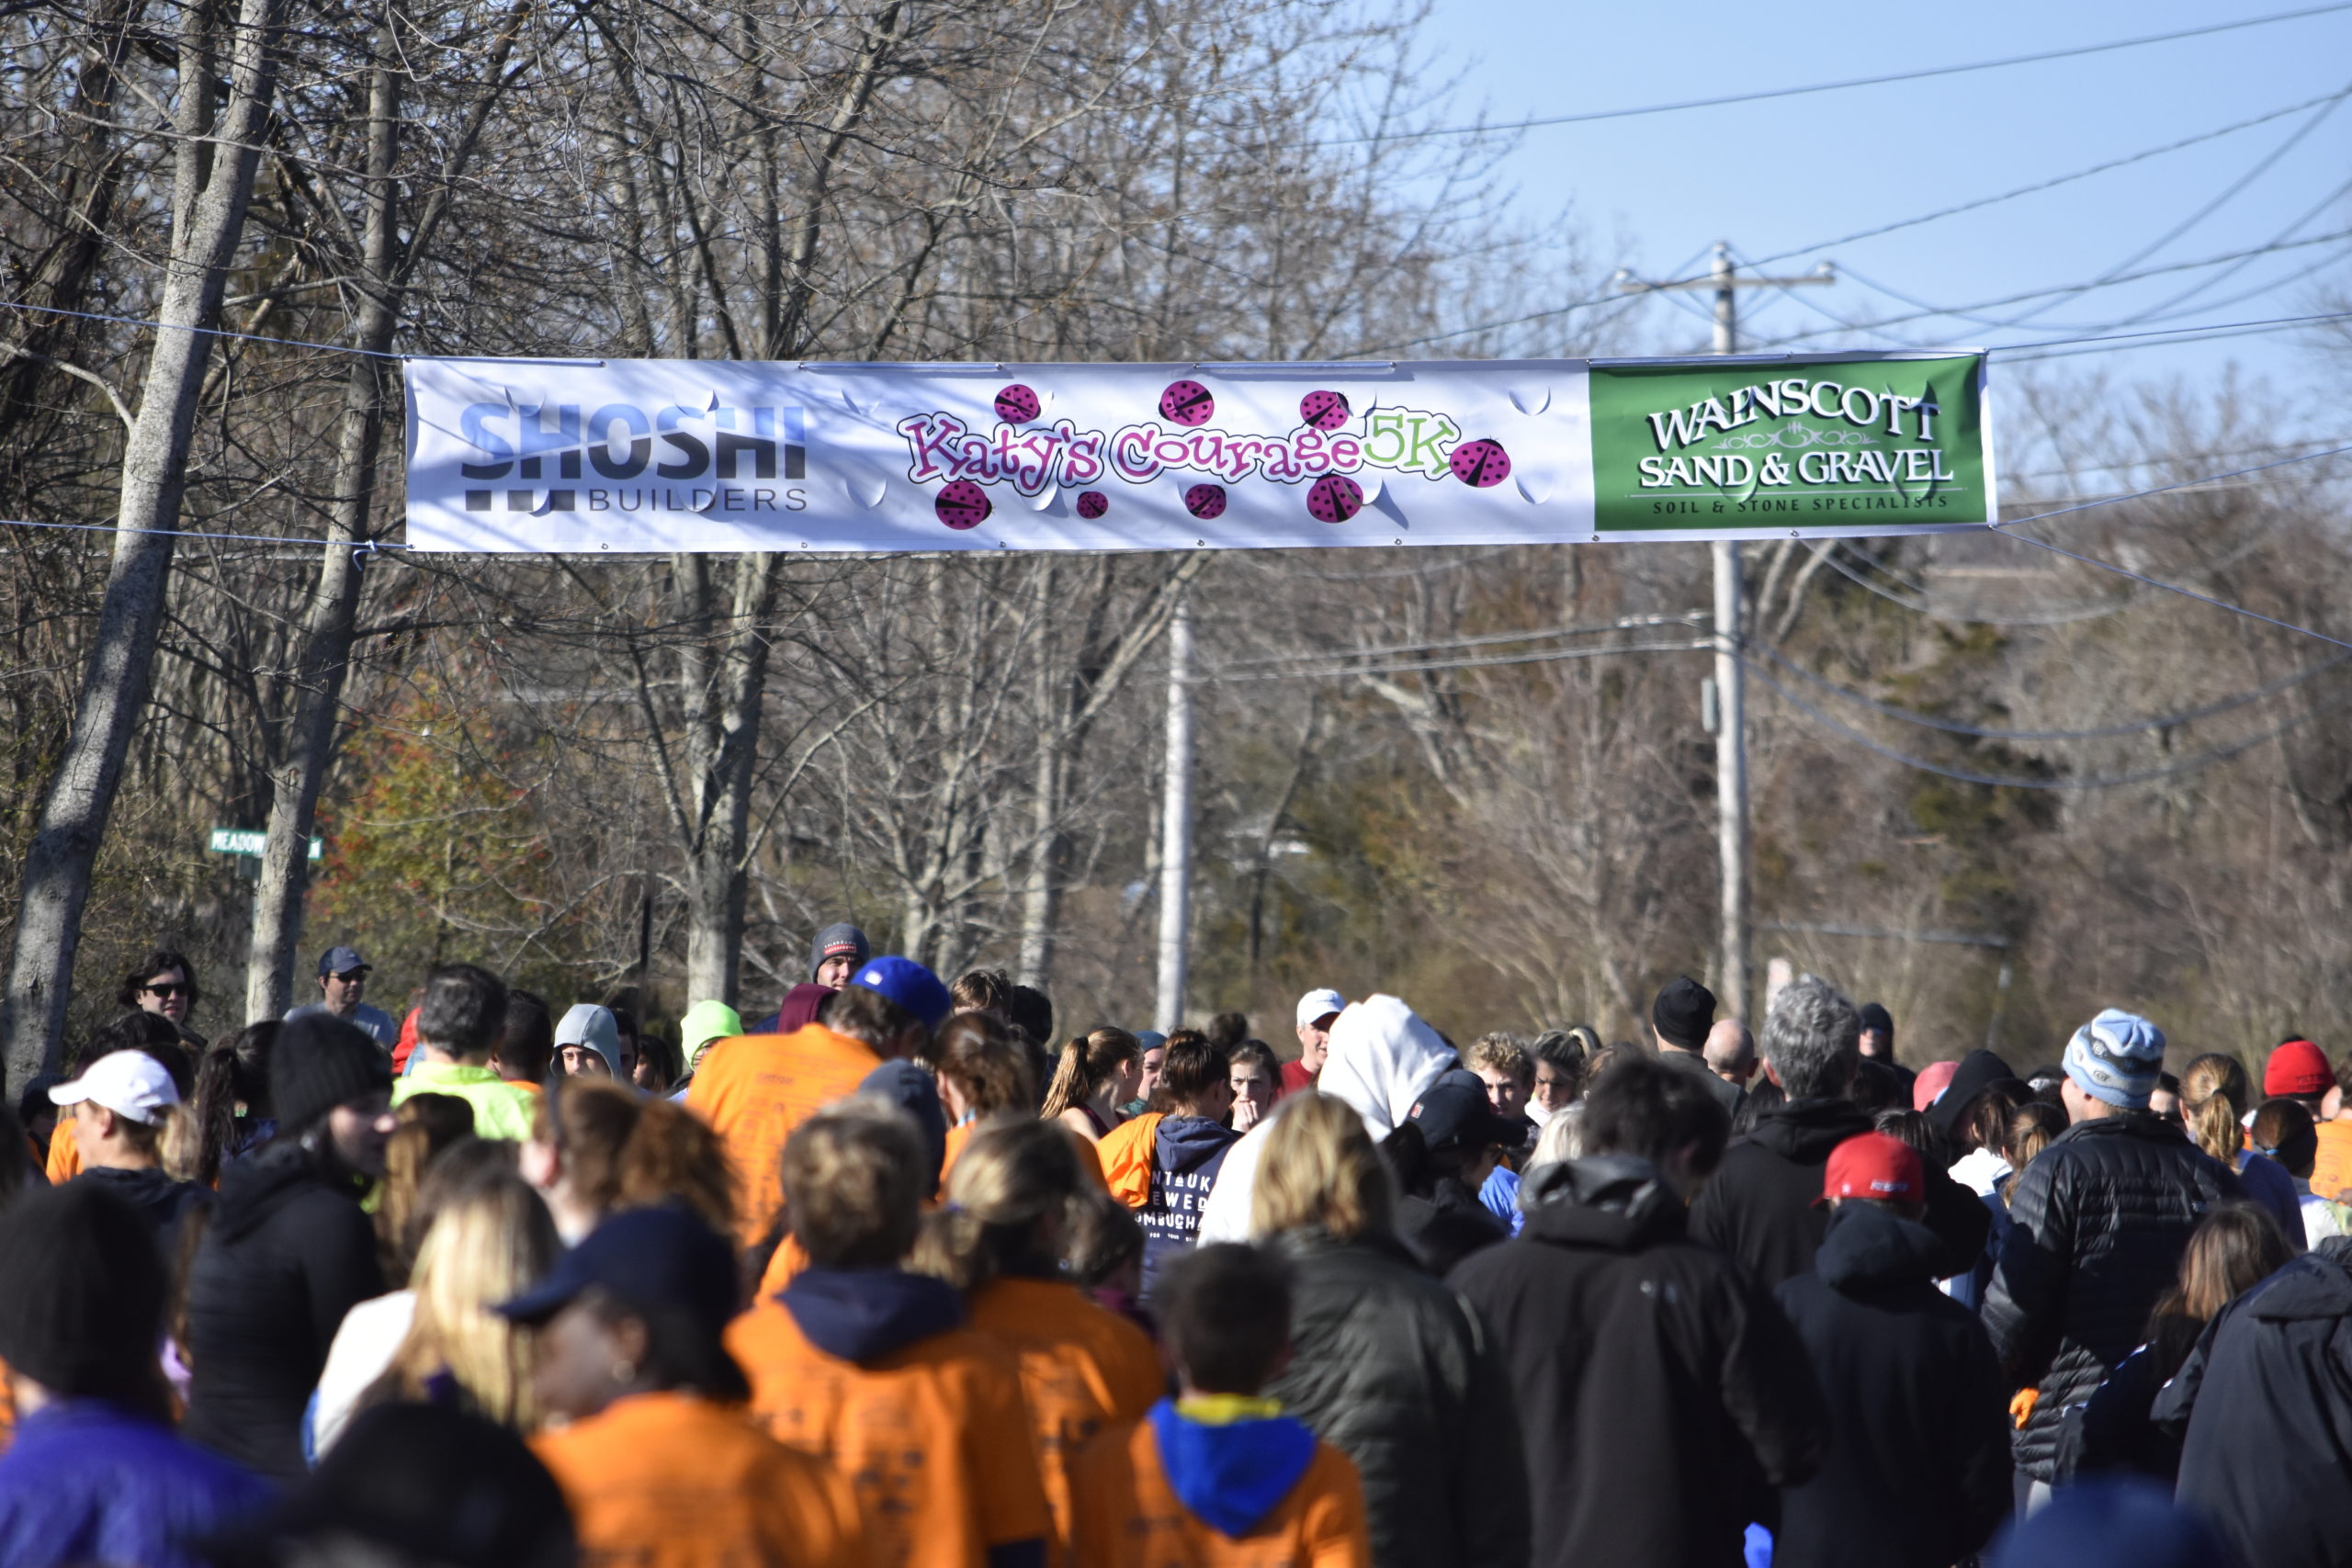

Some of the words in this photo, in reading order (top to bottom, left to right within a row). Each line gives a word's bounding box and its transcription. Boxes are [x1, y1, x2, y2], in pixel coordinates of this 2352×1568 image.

[1649, 378, 1940, 450] WAINSCOTT
[460, 402, 806, 480] SHOSHI
[904, 419, 1100, 491] Katy's
[1115, 426, 1360, 479] Courage
[1364, 415, 1458, 476] 5K
[1640, 455, 1755, 489] SAND
[1759, 453, 1792, 487] &
[1798, 449, 1954, 485] GRAVEL
[589, 488, 808, 512] BUILDERS
[1653, 500, 1701, 514] SOIL
[1713, 500, 1726, 514] &
[1737, 498, 1800, 513] STONE
[1812, 494, 1949, 512] SPECIALISTS
[211, 831, 266, 852] MEADOW
[1152, 1171, 1211, 1191] NTAUK
[1153, 1191, 1207, 1212] EWED
